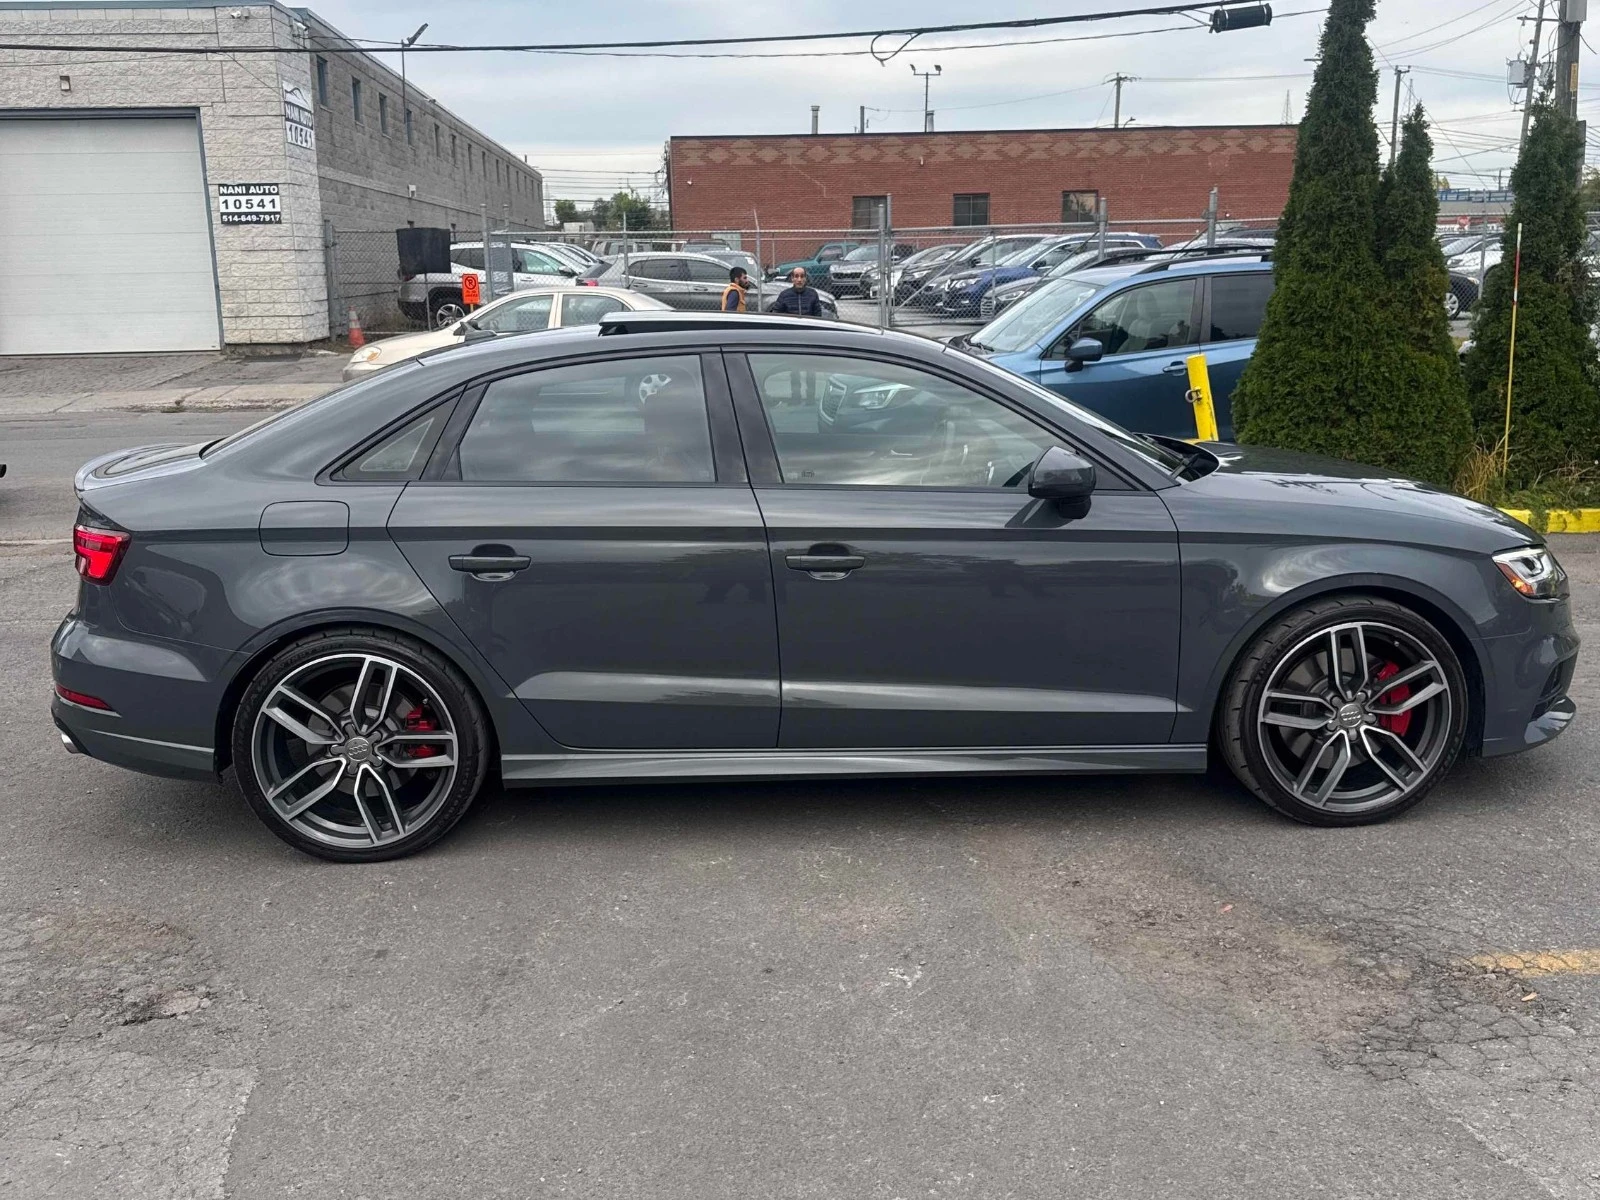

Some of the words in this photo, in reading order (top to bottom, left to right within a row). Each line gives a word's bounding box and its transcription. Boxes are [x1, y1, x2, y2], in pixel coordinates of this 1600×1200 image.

[289, 124, 313, 147] 10541
[219, 185, 246, 194] NANI
[249, 185, 278, 194] AUTO
[221, 198, 276, 210] 10541
[222, 214, 280, 222] 514-649-7917
